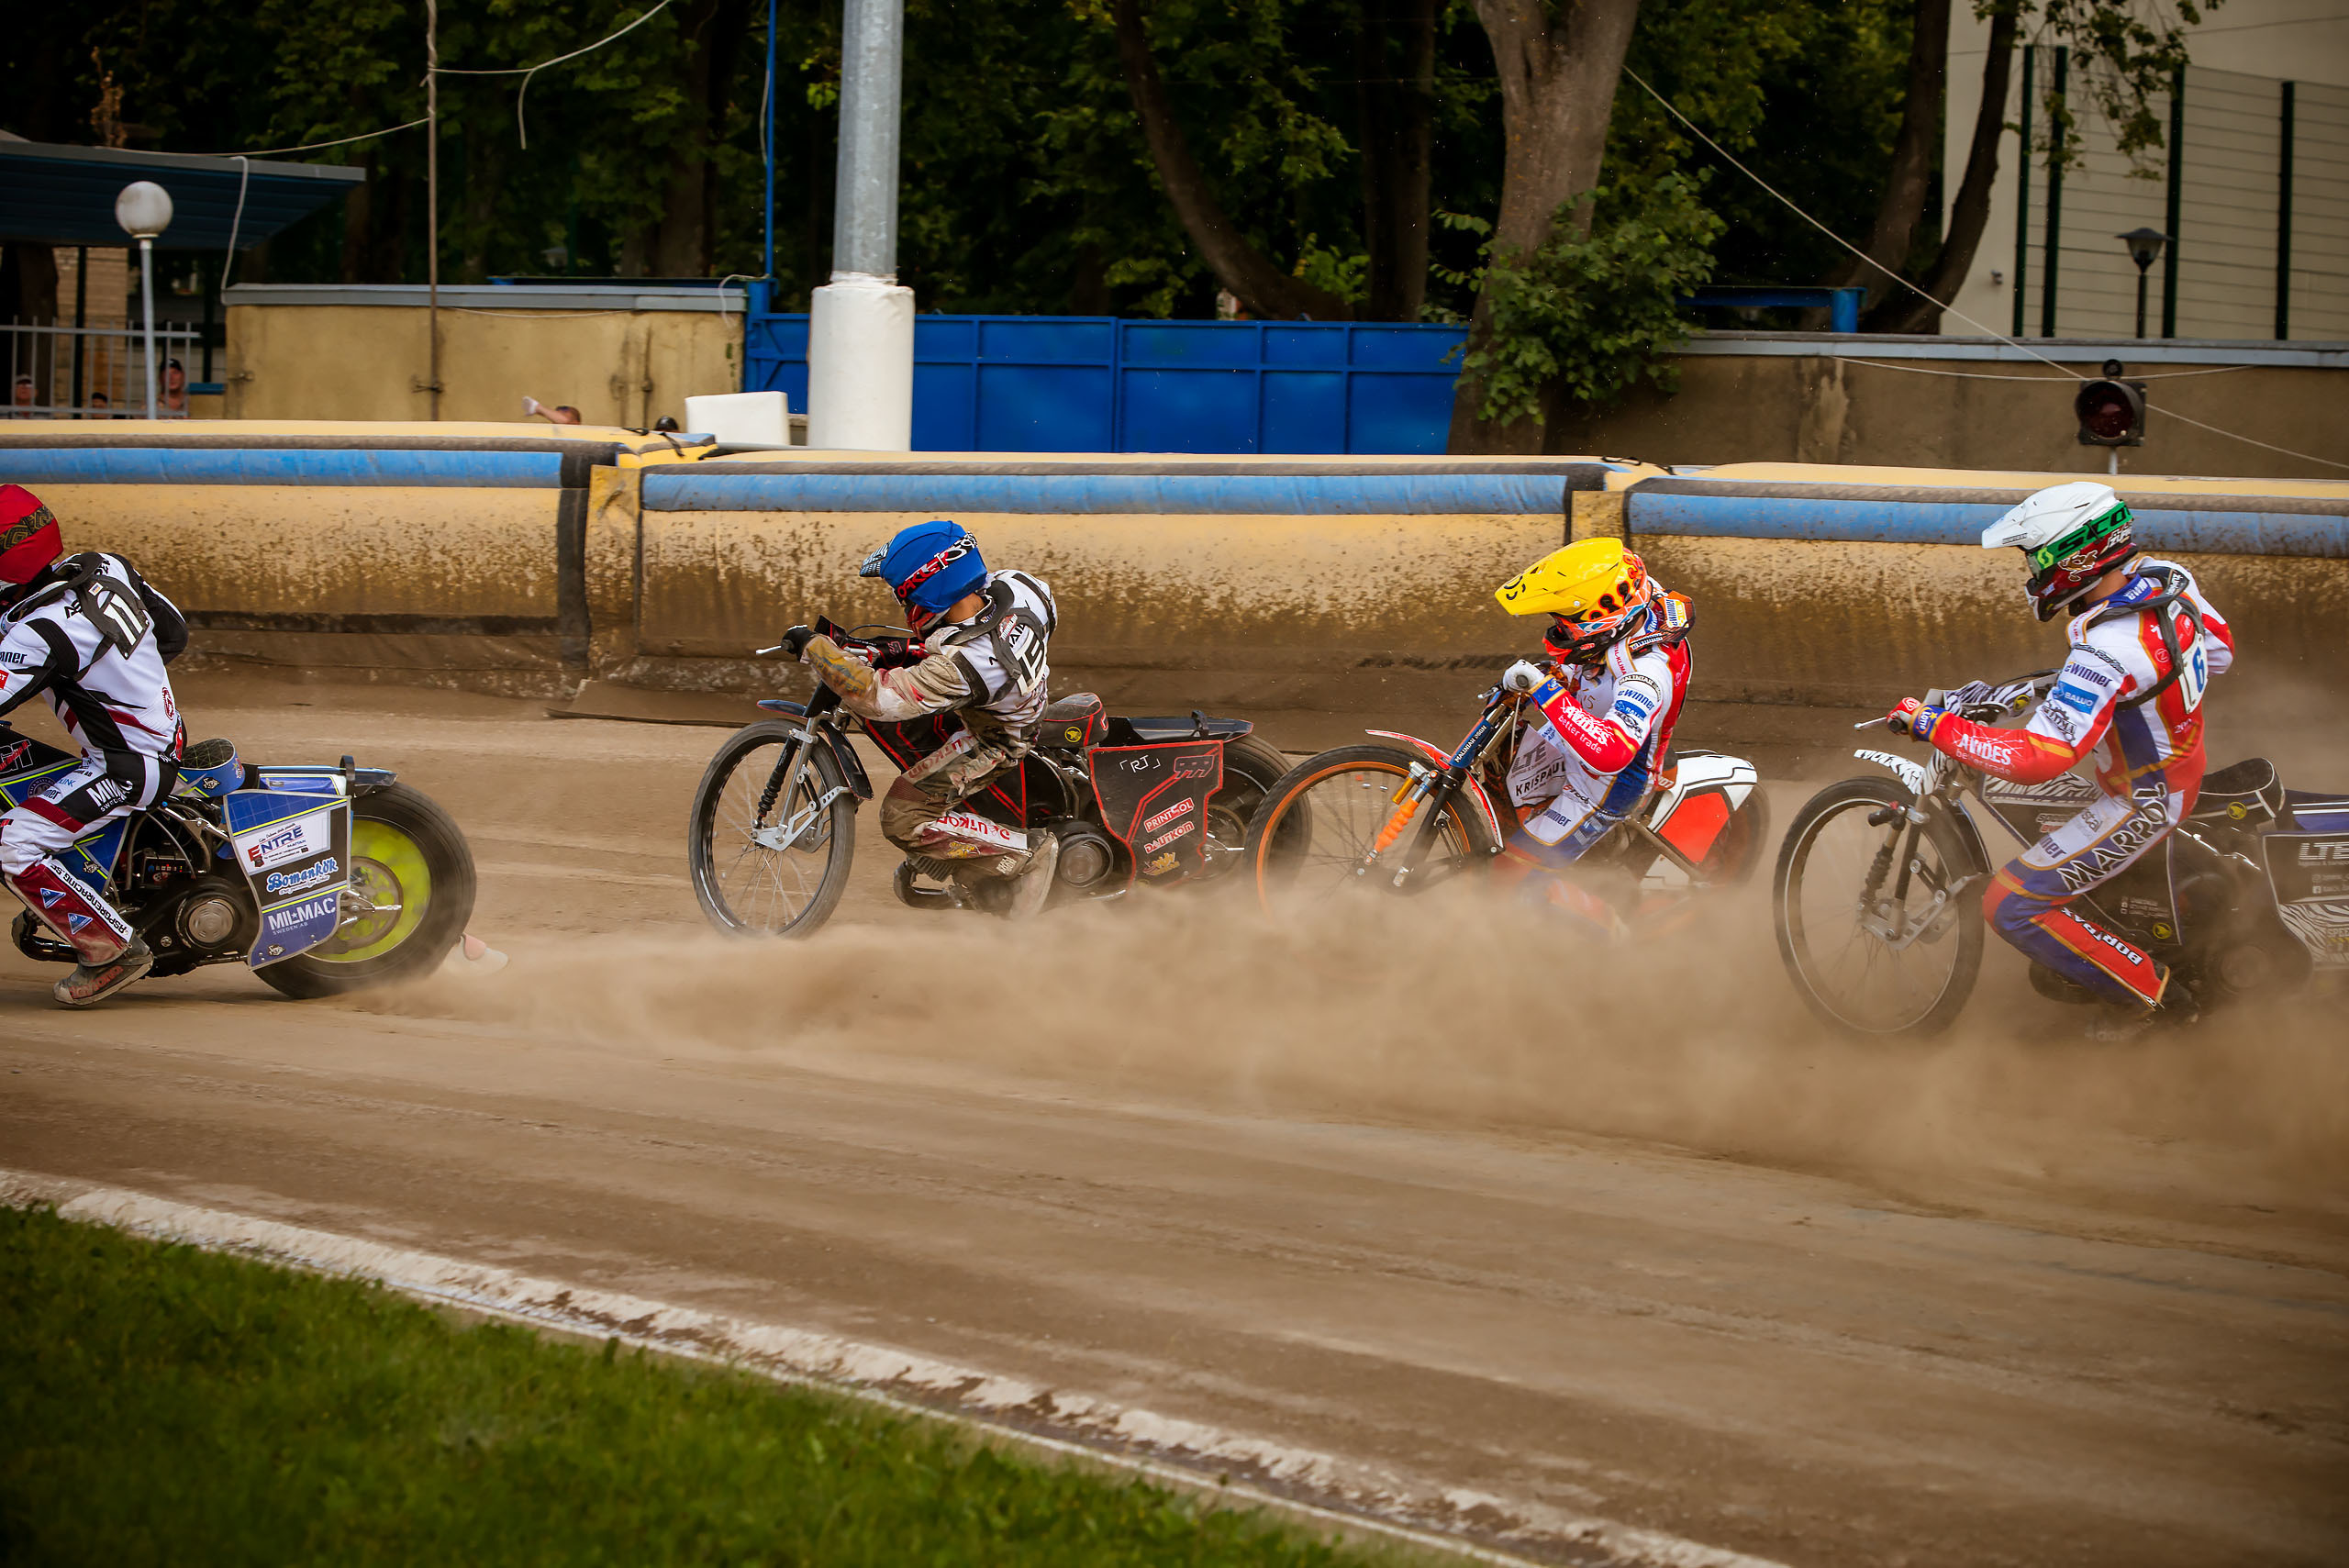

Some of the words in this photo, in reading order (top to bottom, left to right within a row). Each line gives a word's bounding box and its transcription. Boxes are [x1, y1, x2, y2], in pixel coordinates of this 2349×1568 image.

[103, 593, 143, 646] 11
[2065, 662, 2113, 687] eWinner
[1618, 689, 1654, 711] eWinner
[1579, 731, 1602, 754] trade
